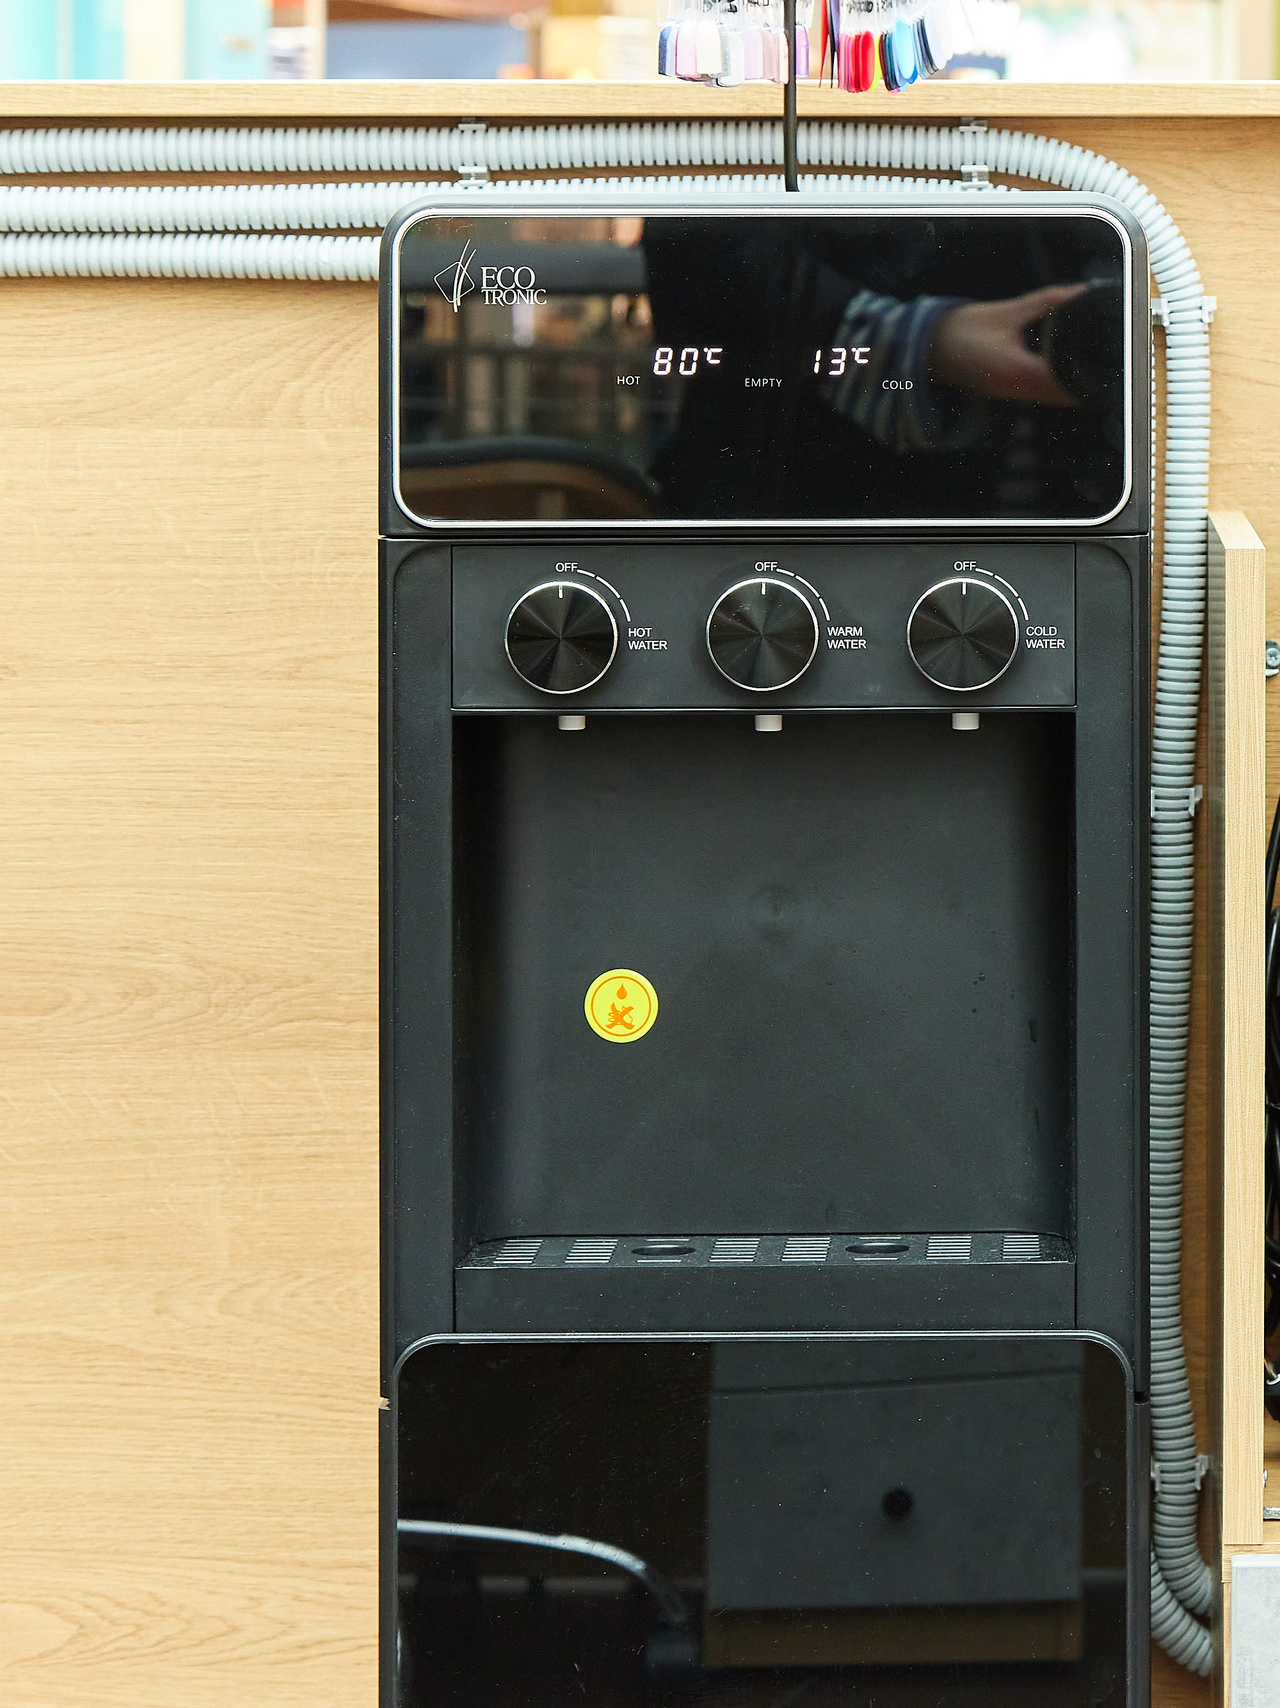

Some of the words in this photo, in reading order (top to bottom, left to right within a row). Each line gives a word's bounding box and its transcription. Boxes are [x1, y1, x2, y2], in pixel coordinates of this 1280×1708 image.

[481, 267, 535, 290] ECO
[481, 288, 547, 307] TRONIC
[617, 375, 641, 386] HOT
[744, 377, 782, 388] EMPTY
[882, 379, 914, 390] COLD
[555, 562, 578, 573] OFF
[754, 561, 777, 573] OFF
[953, 561, 976, 572] OFF
[628, 627, 653, 638] HOT
[827, 626, 863, 637] WARM
[1025, 625, 1058, 637] COLD
[627, 640, 668, 651] WATER
[827, 639, 867, 650] WATER
[1025, 638, 1066, 649] WATER
